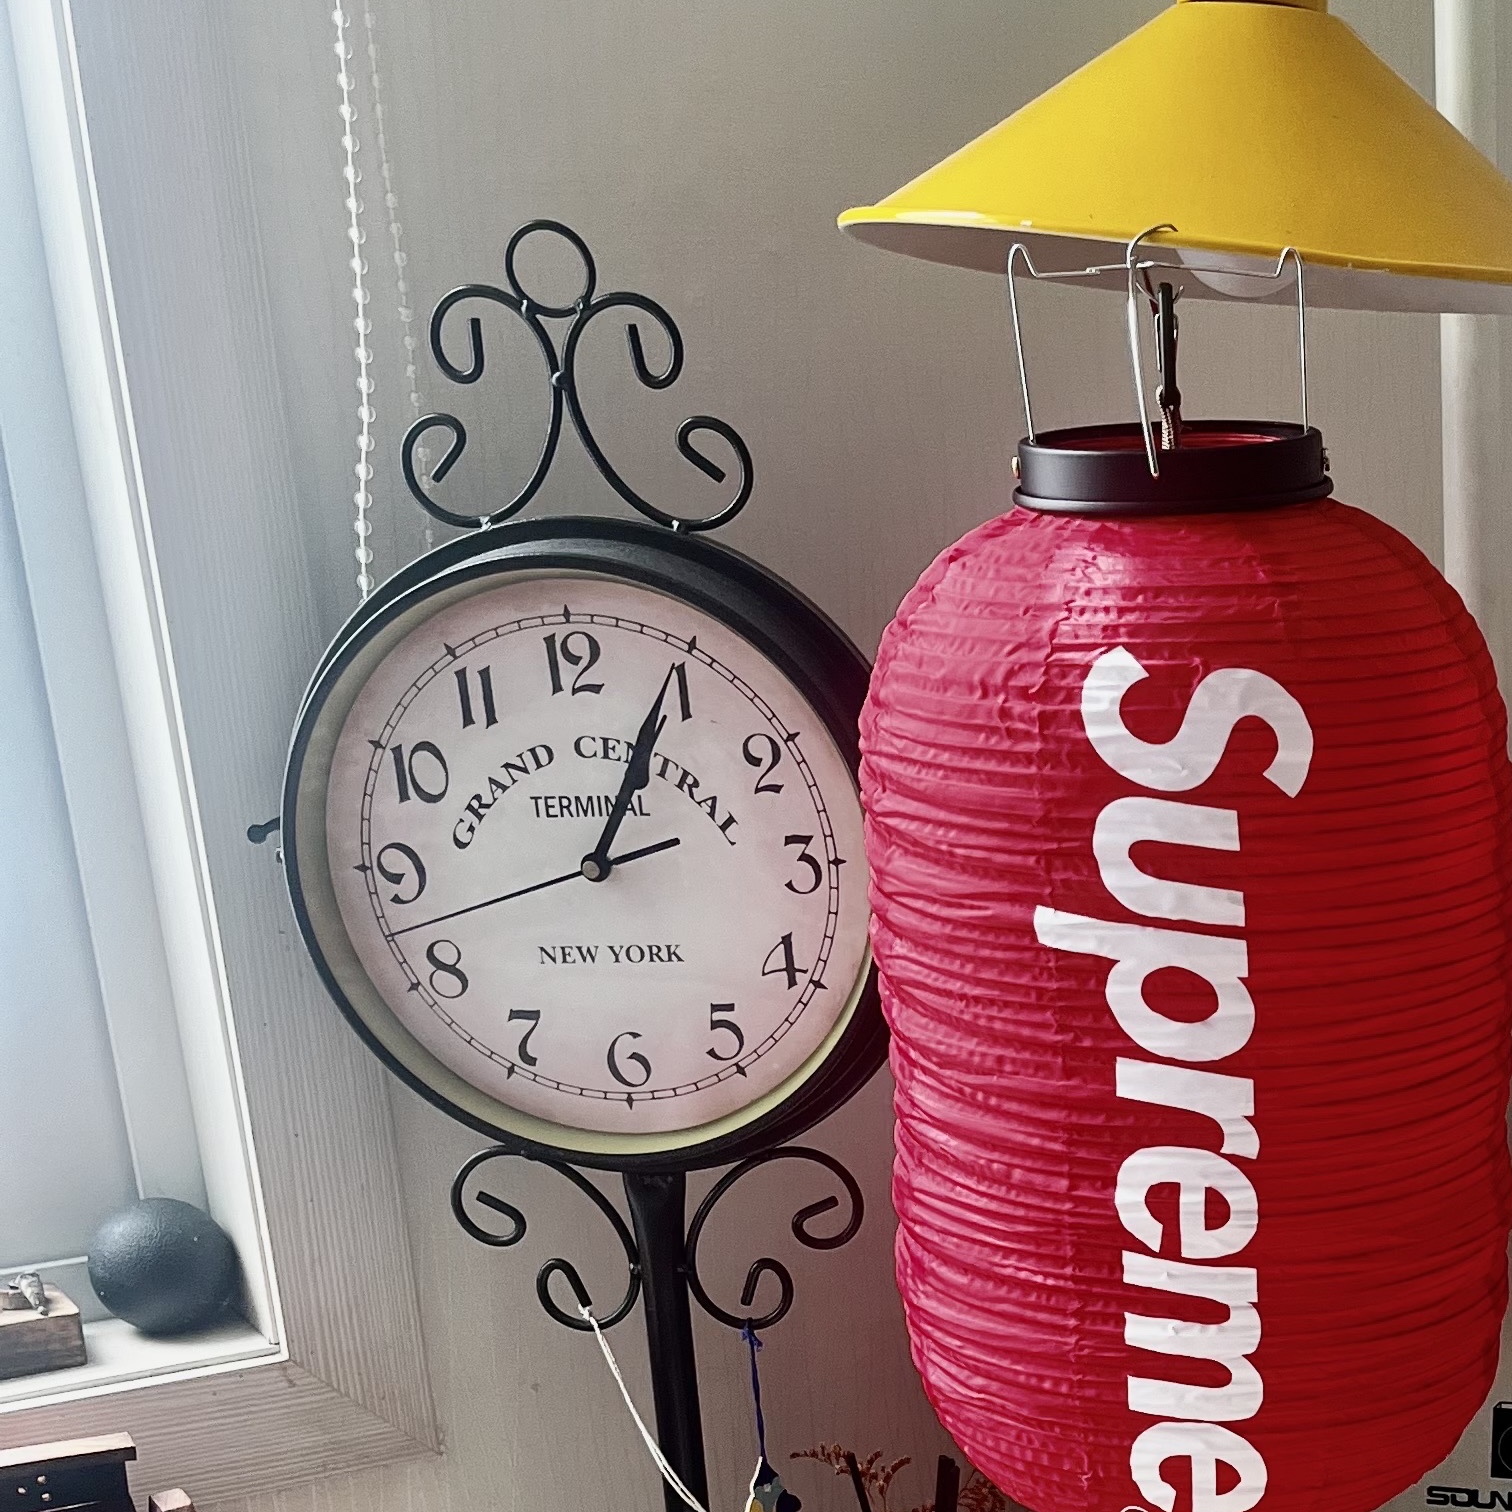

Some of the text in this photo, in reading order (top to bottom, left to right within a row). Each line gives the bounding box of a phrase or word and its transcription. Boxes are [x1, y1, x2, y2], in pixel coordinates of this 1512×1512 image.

[541, 630, 605, 696] 12
[677, 661, 693, 721] 1
[453, 664, 499, 730] 11
[390, 740, 450, 804] 10
[742, 733, 784, 794] 2
[452, 743, 555, 850] GRAND
[530, 795, 651, 818] TERMINAL
[376, 842, 427, 905] 9
[782, 834, 823, 895] 3
[425, 939, 470, 999] 8
[538, 944, 685, 965] NEW YORK
[761, 931, 809, 990] 4
[507, 1008, 542, 1067] 7
[606, 1031, 652, 1088] 6
[706, 1002, 745, 1061] 5
